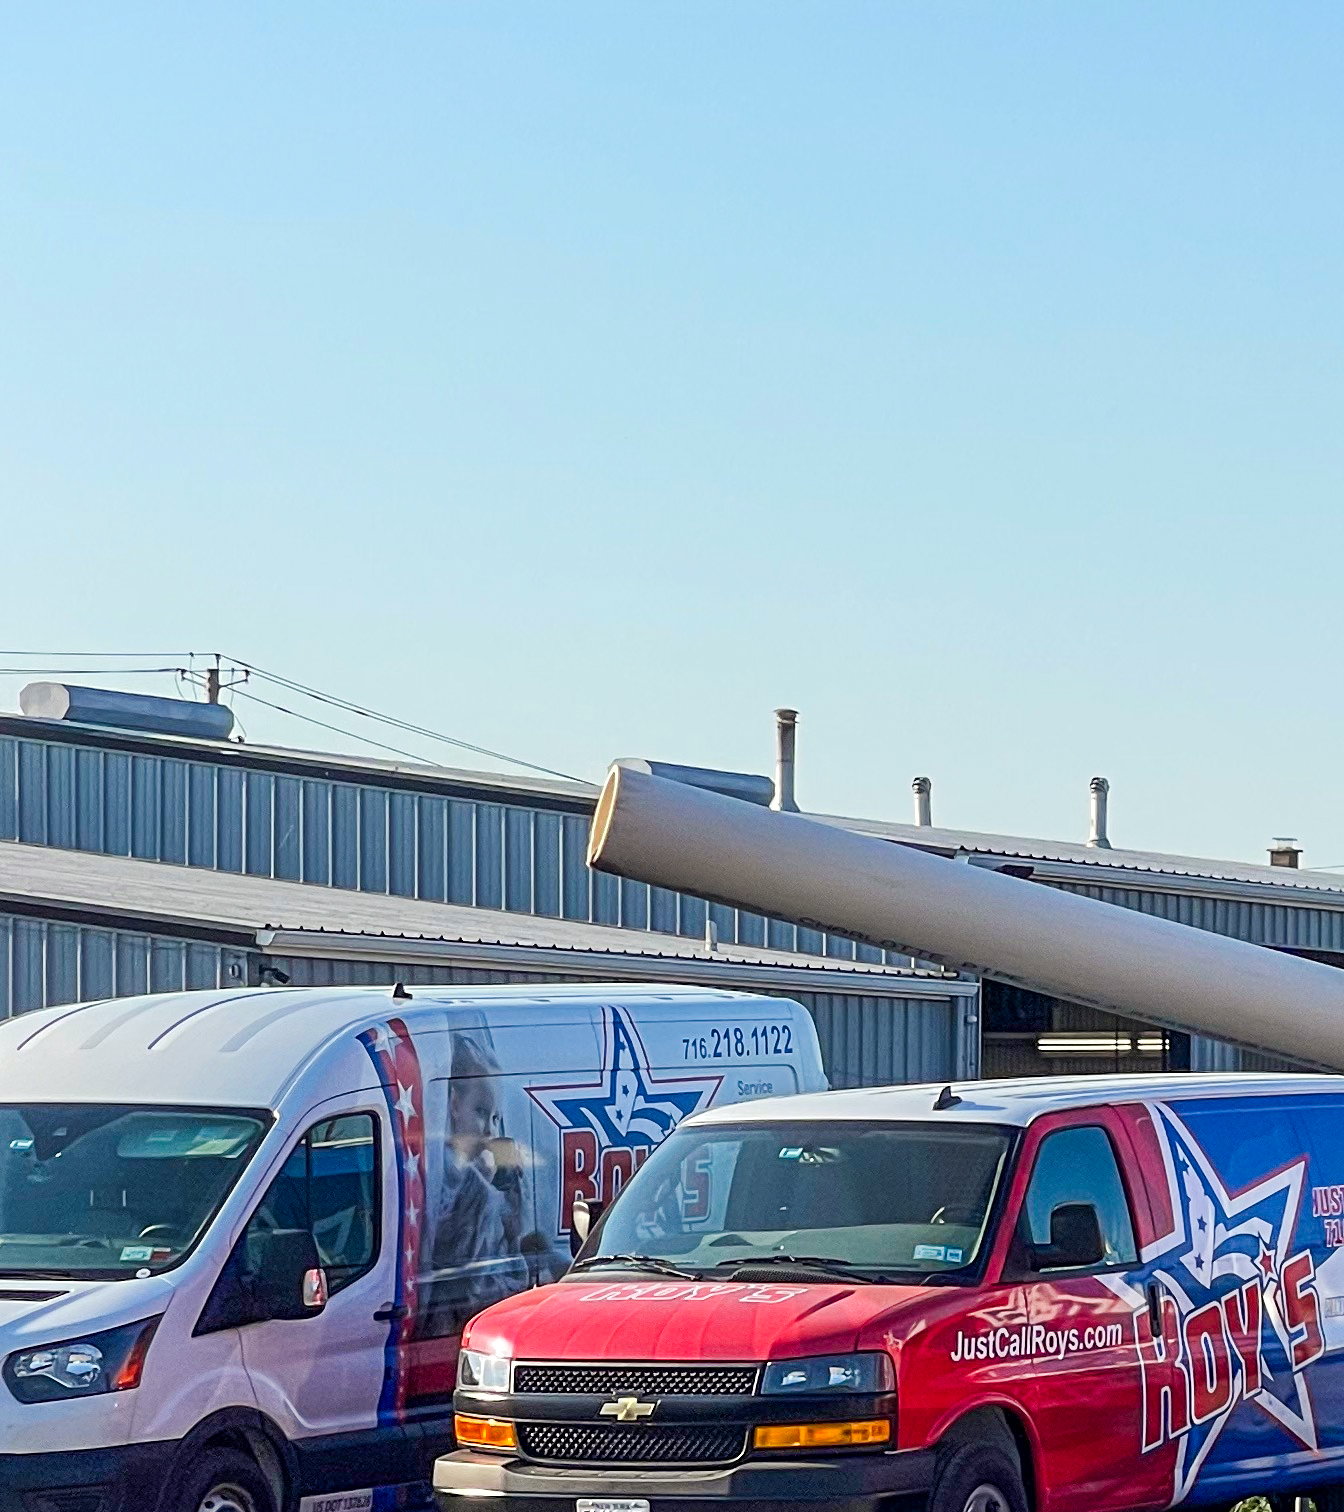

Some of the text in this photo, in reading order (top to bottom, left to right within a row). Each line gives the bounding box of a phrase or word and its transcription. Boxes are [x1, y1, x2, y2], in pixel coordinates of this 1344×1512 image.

[682, 1025, 793, 1060] 716.218.1122
[737, 1080, 774, 1096] Service
[950, 1324, 1123, 1362] JustCallRoys.com
